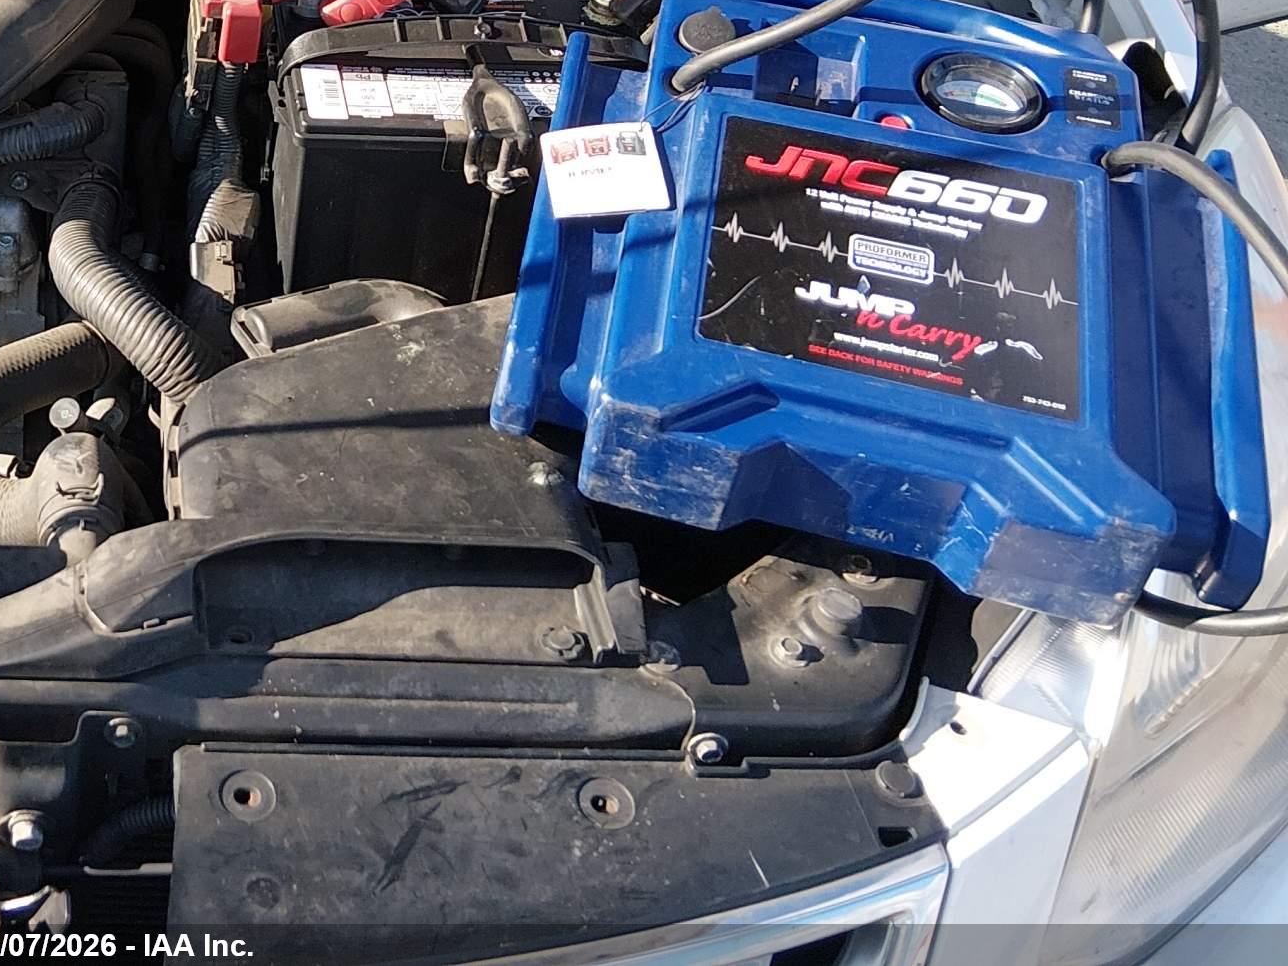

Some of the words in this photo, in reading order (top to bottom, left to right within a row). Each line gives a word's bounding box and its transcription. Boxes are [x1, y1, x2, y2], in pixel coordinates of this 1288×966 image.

[744, 145, 1048, 224] JNC660
[855, 257, 927, 278] TECHNOLOGY
[857, 241, 927, 263] PROFORMER
[795, 280, 915, 317] JUMP
[888, 313, 983, 361] Carry
[808, 344, 827, 355] SEE
[828, 348, 854, 361] BACK
[855, 354, 875, 366] FOR
[876, 359, 911, 373] SAFETY
